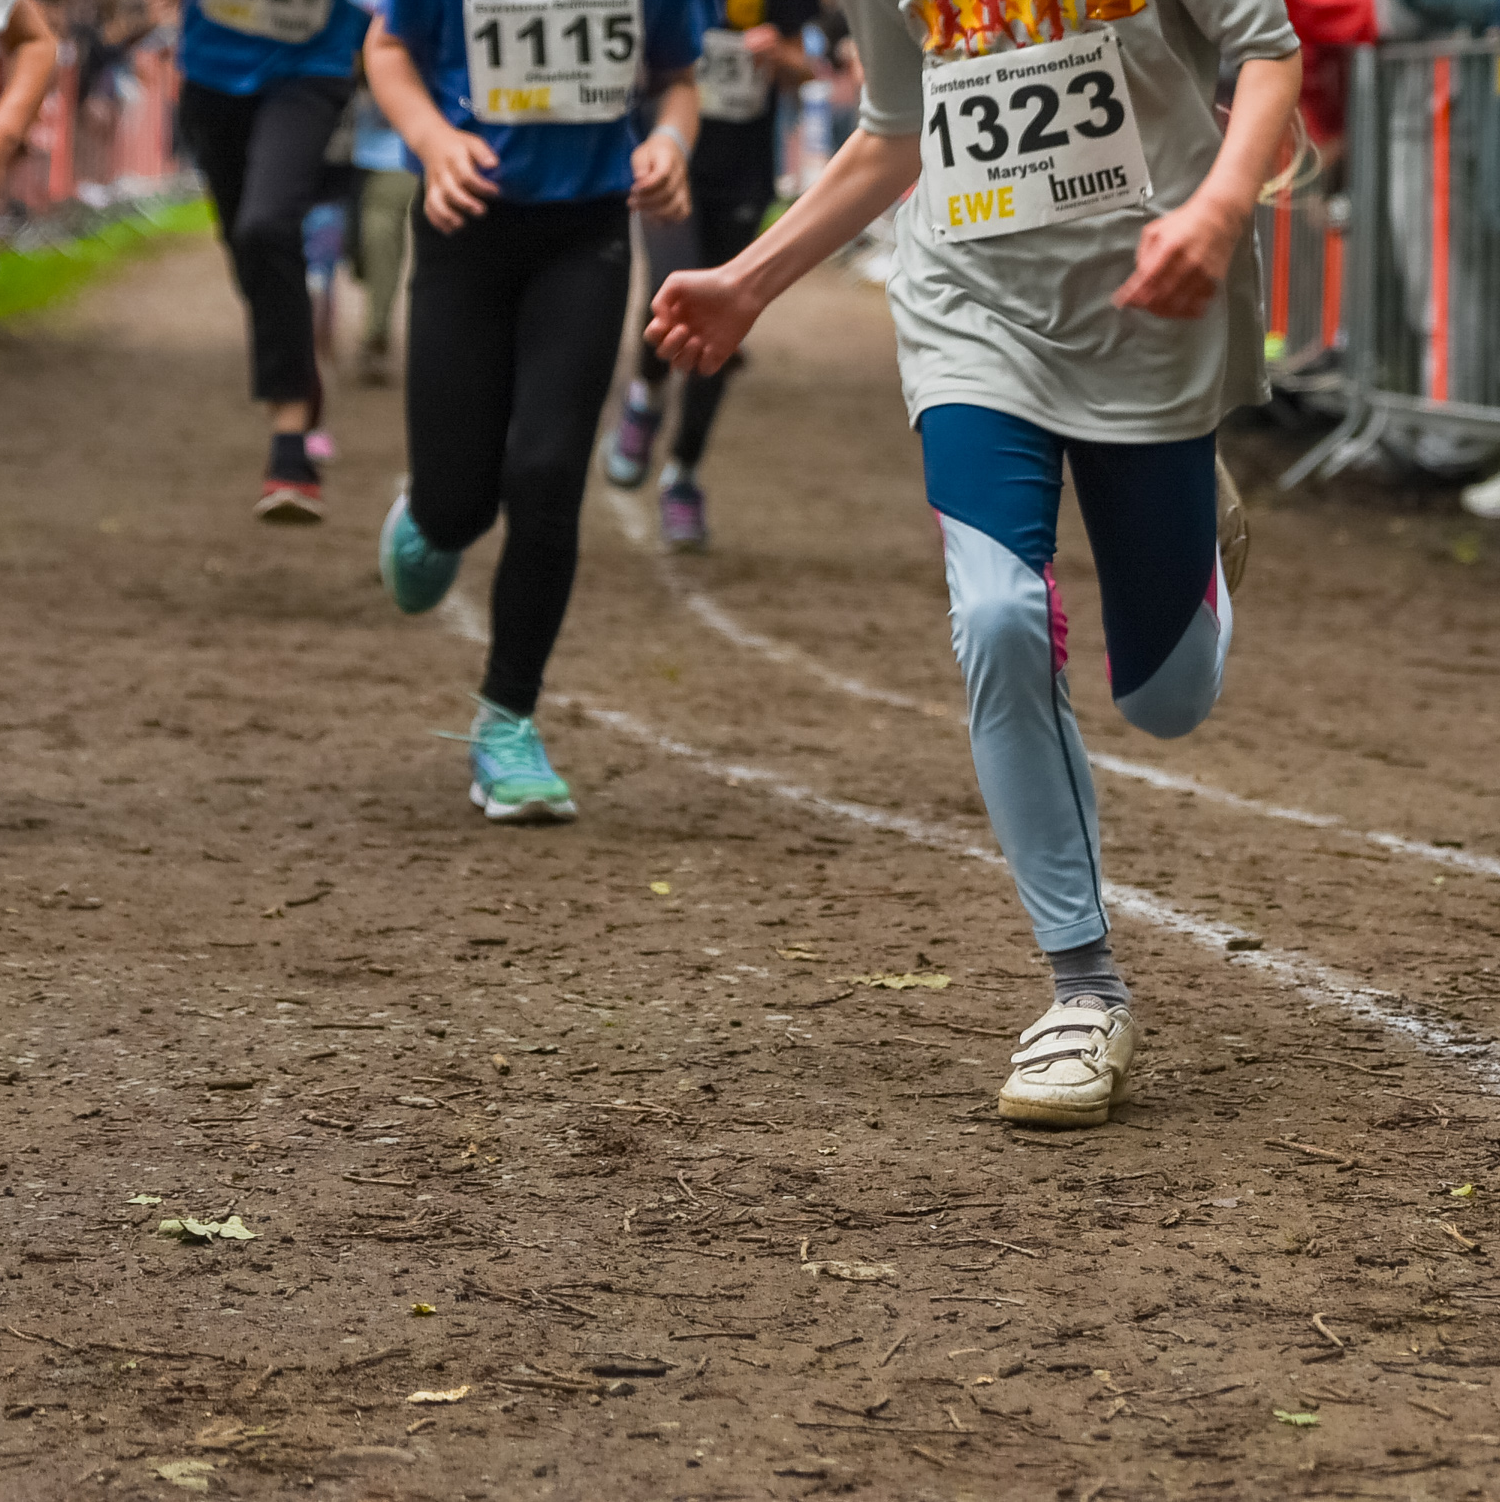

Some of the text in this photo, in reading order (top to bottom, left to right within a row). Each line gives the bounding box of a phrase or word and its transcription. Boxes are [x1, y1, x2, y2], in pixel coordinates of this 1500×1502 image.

[474, 13, 635, 69] 1115
[930, 47, 1103, 96] Everstener Brunnenlauf
[928, 70, 1125, 169] 1323
[948, 185, 1015, 227] EWE
[1048, 165, 1128, 203] bruns
[986, 155, 1055, 182] Marysol
